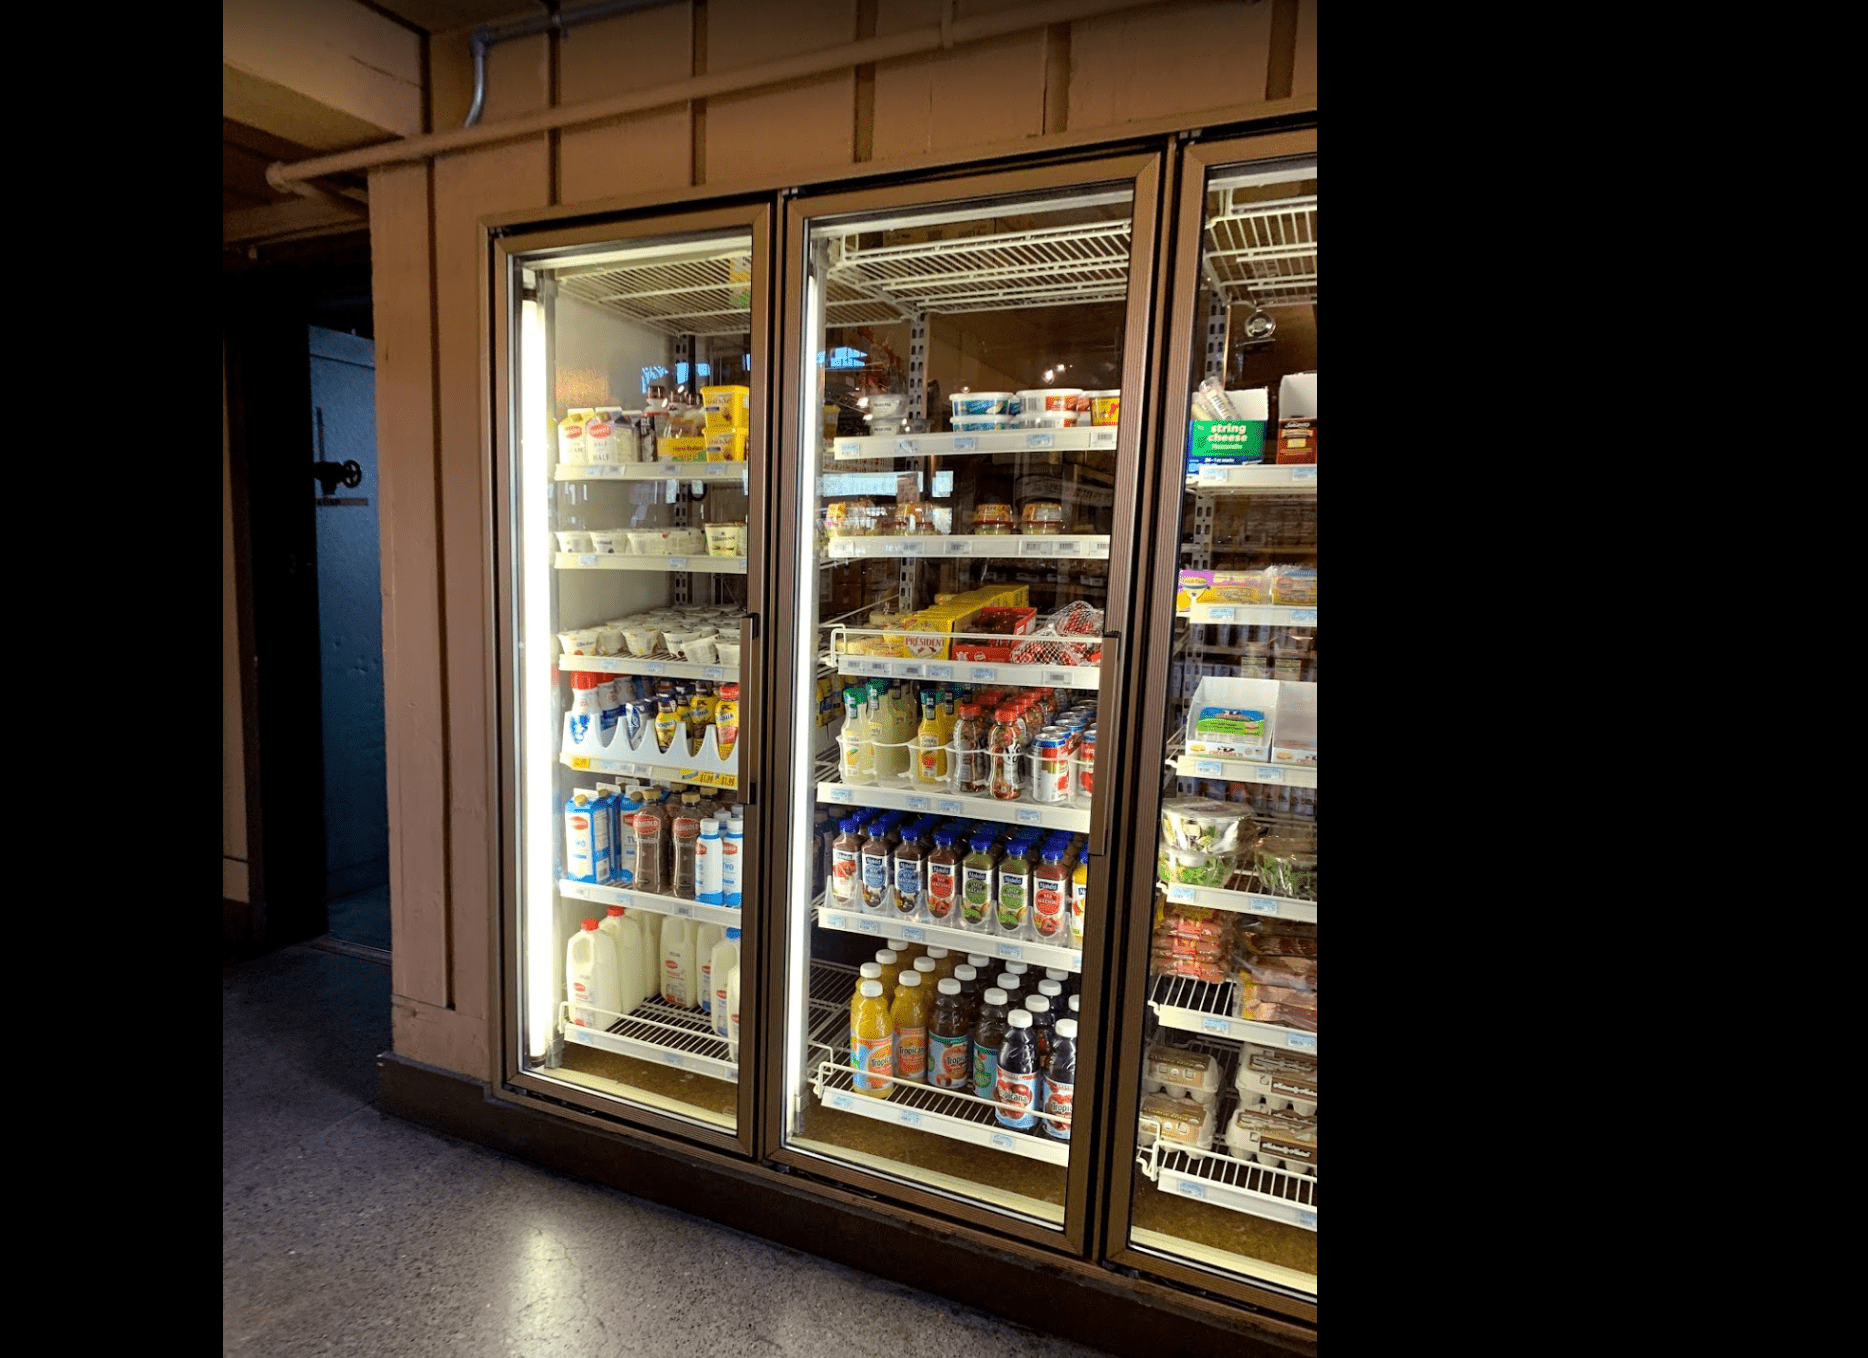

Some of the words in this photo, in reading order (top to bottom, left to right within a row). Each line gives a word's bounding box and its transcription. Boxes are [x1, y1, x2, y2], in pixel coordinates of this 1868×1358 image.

[1211, 423, 1247, 434] string
[1207, 434, 1248, 442] cheese
[1039, 882, 1057, 890] Naked
[899, 1047, 925, 1055] Tropican
[1052, 1102, 1073, 1112] Tropic
